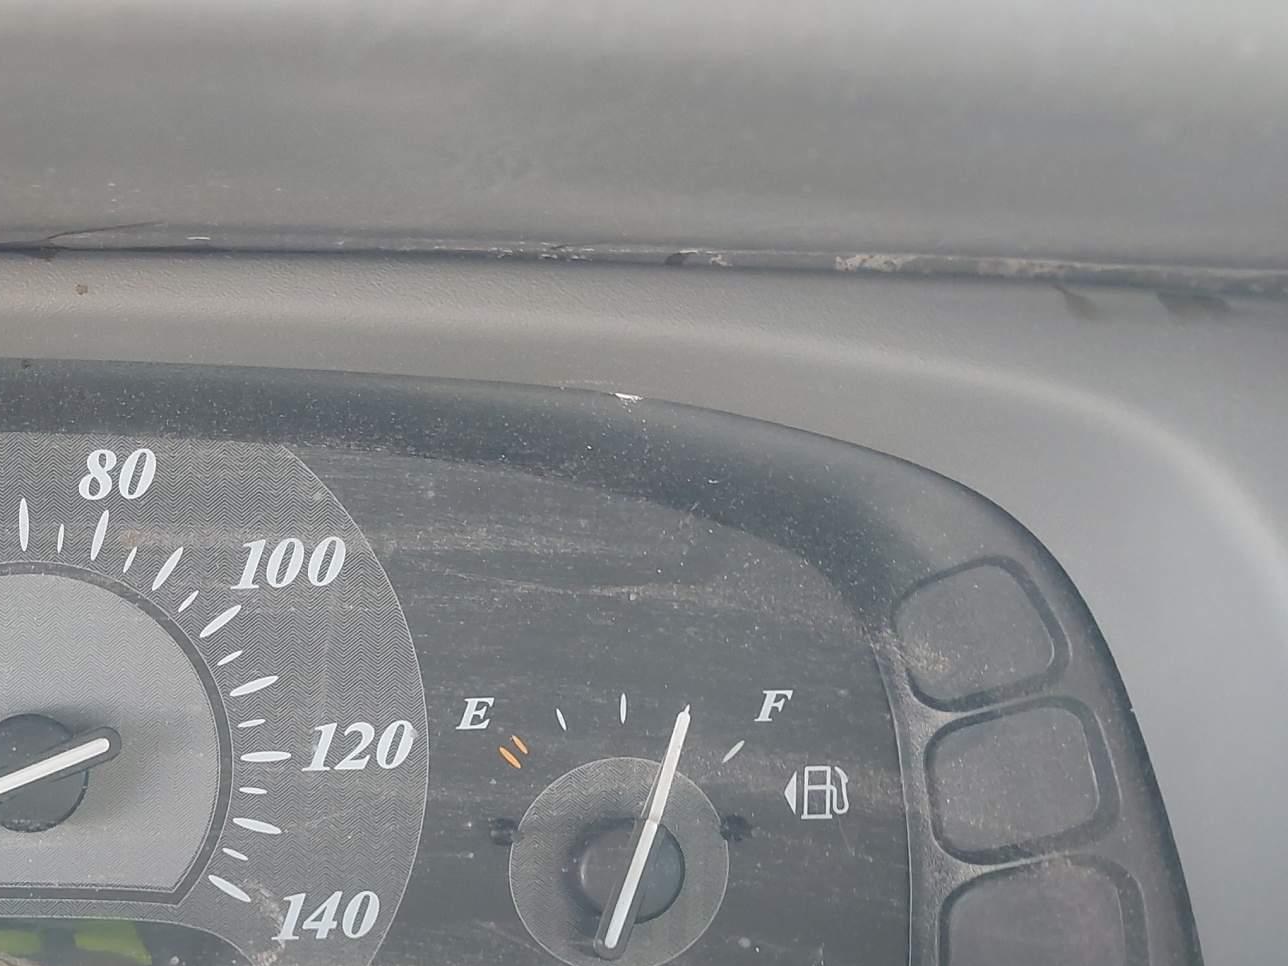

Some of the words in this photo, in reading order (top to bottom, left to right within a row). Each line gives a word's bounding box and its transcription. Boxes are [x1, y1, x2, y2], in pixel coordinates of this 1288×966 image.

[78, 448, 157, 501] 80
[230, 536, 347, 590] 100
[456, 697, 495, 730] E
[754, 689, 793, 722] F
[301, 719, 414, 772] 120
[271, 890, 380, 944] 140
